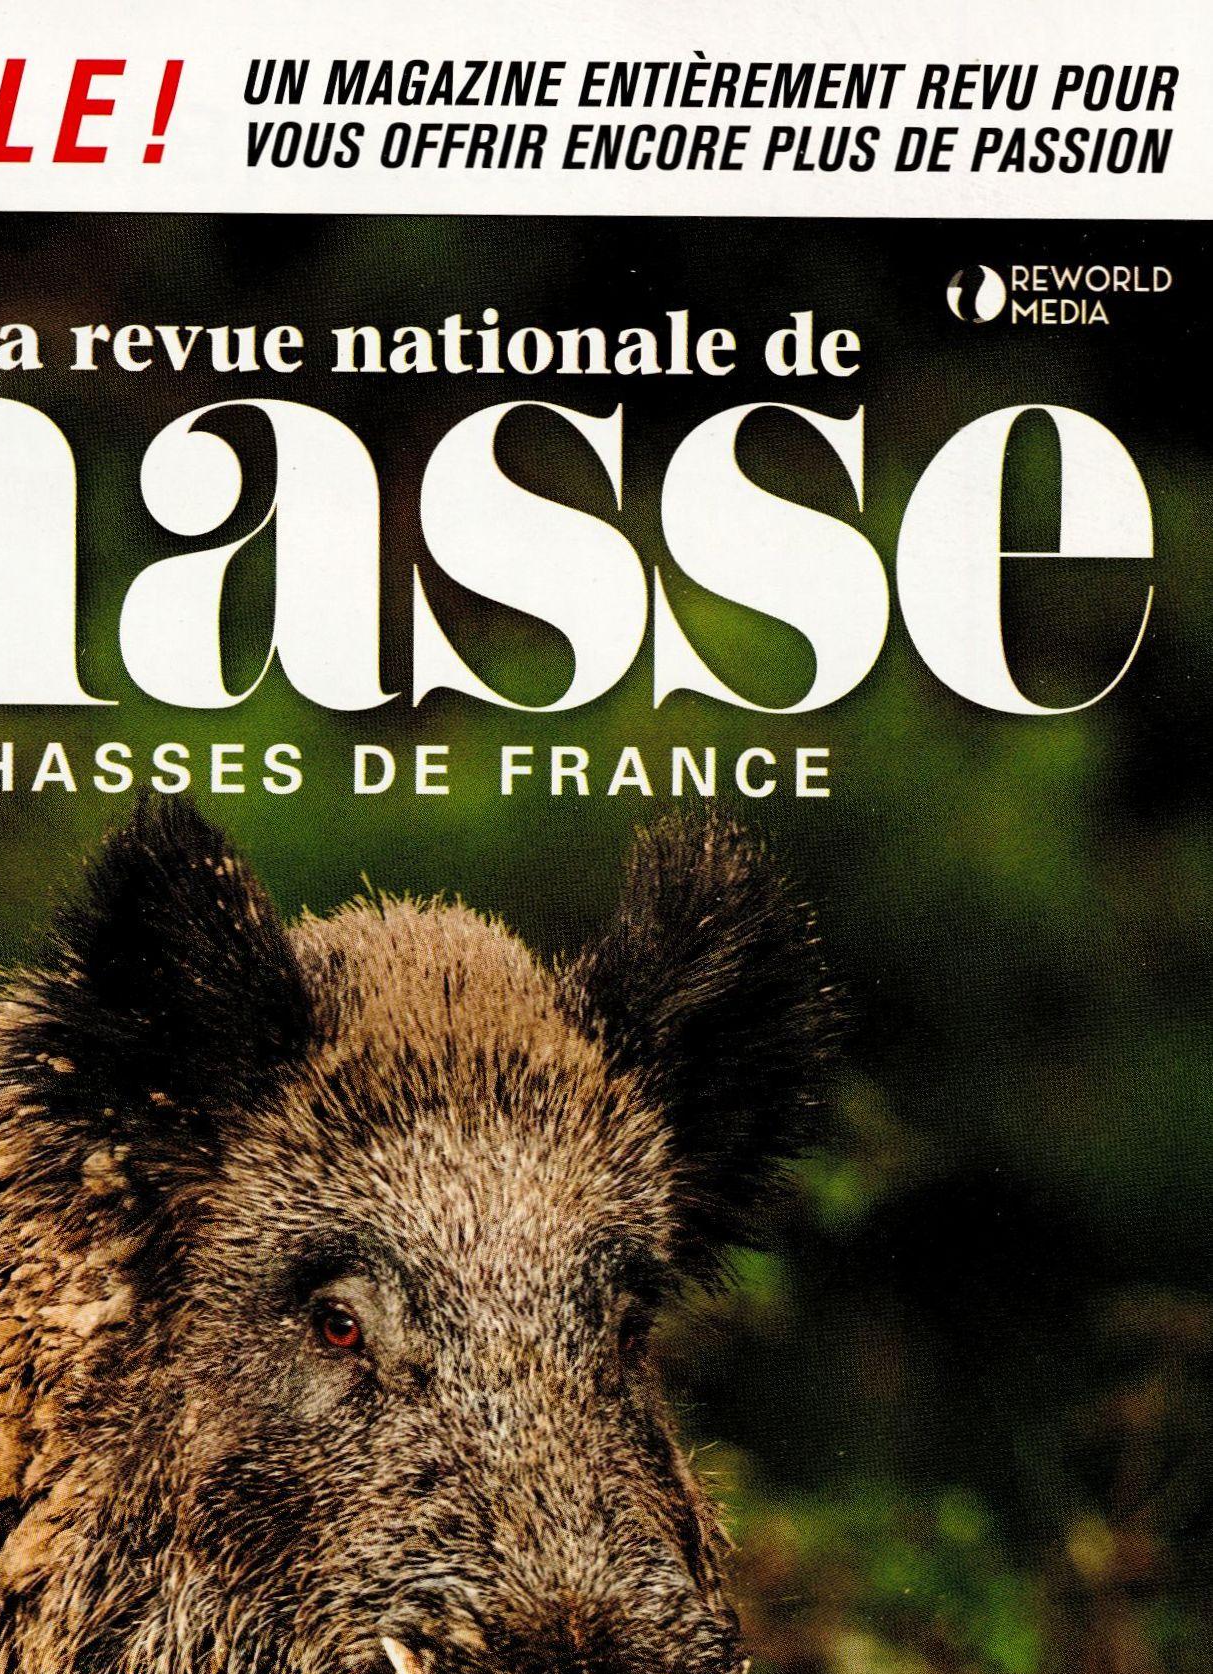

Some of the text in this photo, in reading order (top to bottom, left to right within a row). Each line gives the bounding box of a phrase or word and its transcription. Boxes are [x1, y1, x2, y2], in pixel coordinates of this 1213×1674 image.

[244, 51, 1179, 111] UN MAGAZINE ENTIÈREMENT REVU POUR
[248, 122, 1173, 173] VOUS OFFRIR ENCORE PLUS DE PASSION
[1012, 265, 1173, 325] REWORLD MEDIA
[71, 324, 303, 373] revue
[332, 308, 736, 376] nationale
[765, 311, 860, 377] de
[353, 745, 449, 795] DE
[501, 746, 830, 798] FRANCE
